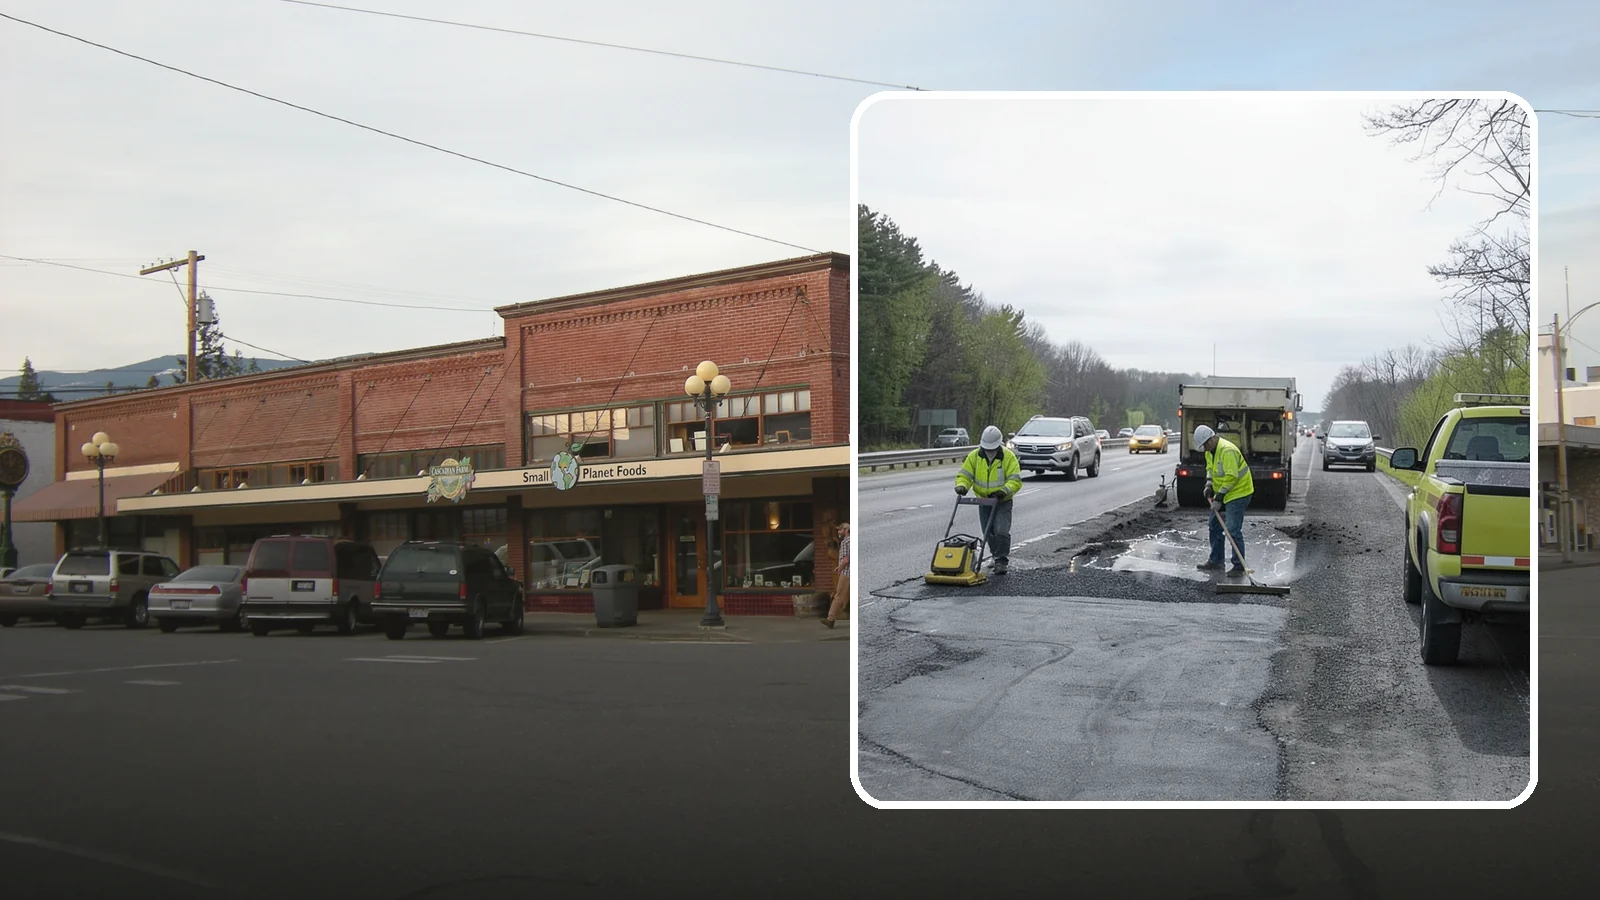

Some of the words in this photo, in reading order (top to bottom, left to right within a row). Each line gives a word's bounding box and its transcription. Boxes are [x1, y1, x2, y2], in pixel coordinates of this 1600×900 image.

[523, 471, 549, 483] Small
[582, 467, 614, 479] Planet
[617, 464, 647, 477] Foods
